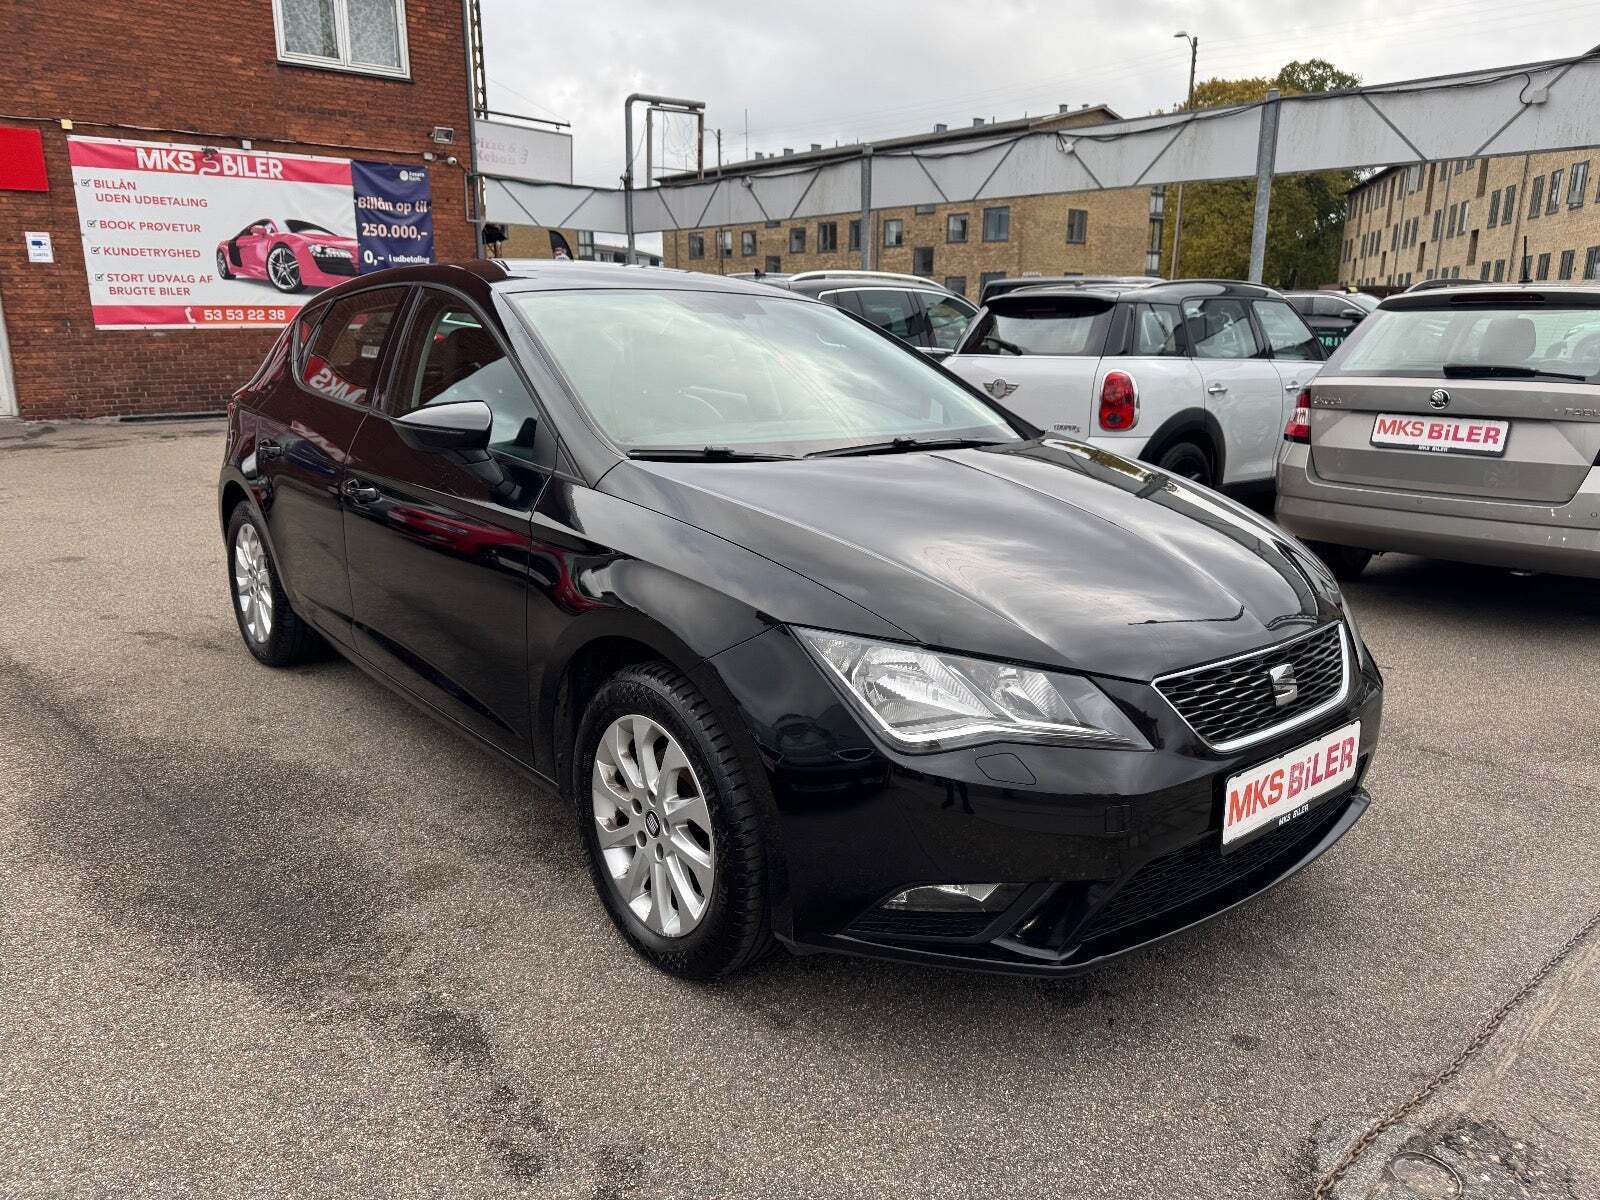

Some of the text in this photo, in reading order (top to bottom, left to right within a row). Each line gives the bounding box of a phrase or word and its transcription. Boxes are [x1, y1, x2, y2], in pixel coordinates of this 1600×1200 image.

[136, 147, 284, 180] MKS BILER
[94, 178, 136, 191] BILLÅN
[96, 193, 208, 208] UDEN UDBETALING
[357, 196, 428, 214] Billån op til
[100, 220, 201, 233] BOOK PRØVETUR
[361, 223, 428, 240] 250.000,-
[103, 247, 201, 258] KUNDETRYGHED
[392, 255, 430, 264] udbetaling
[107, 273, 213, 284] STORT UDVALG AF
[109, 286, 191, 296] BRUGTE BILER
[204, 309, 285, 320] 53 53 22 38
[1376, 418, 1424, 438] MKS
[1227, 768, 1285, 827] MKS
[1278, 814, 1291, 826] MKS
